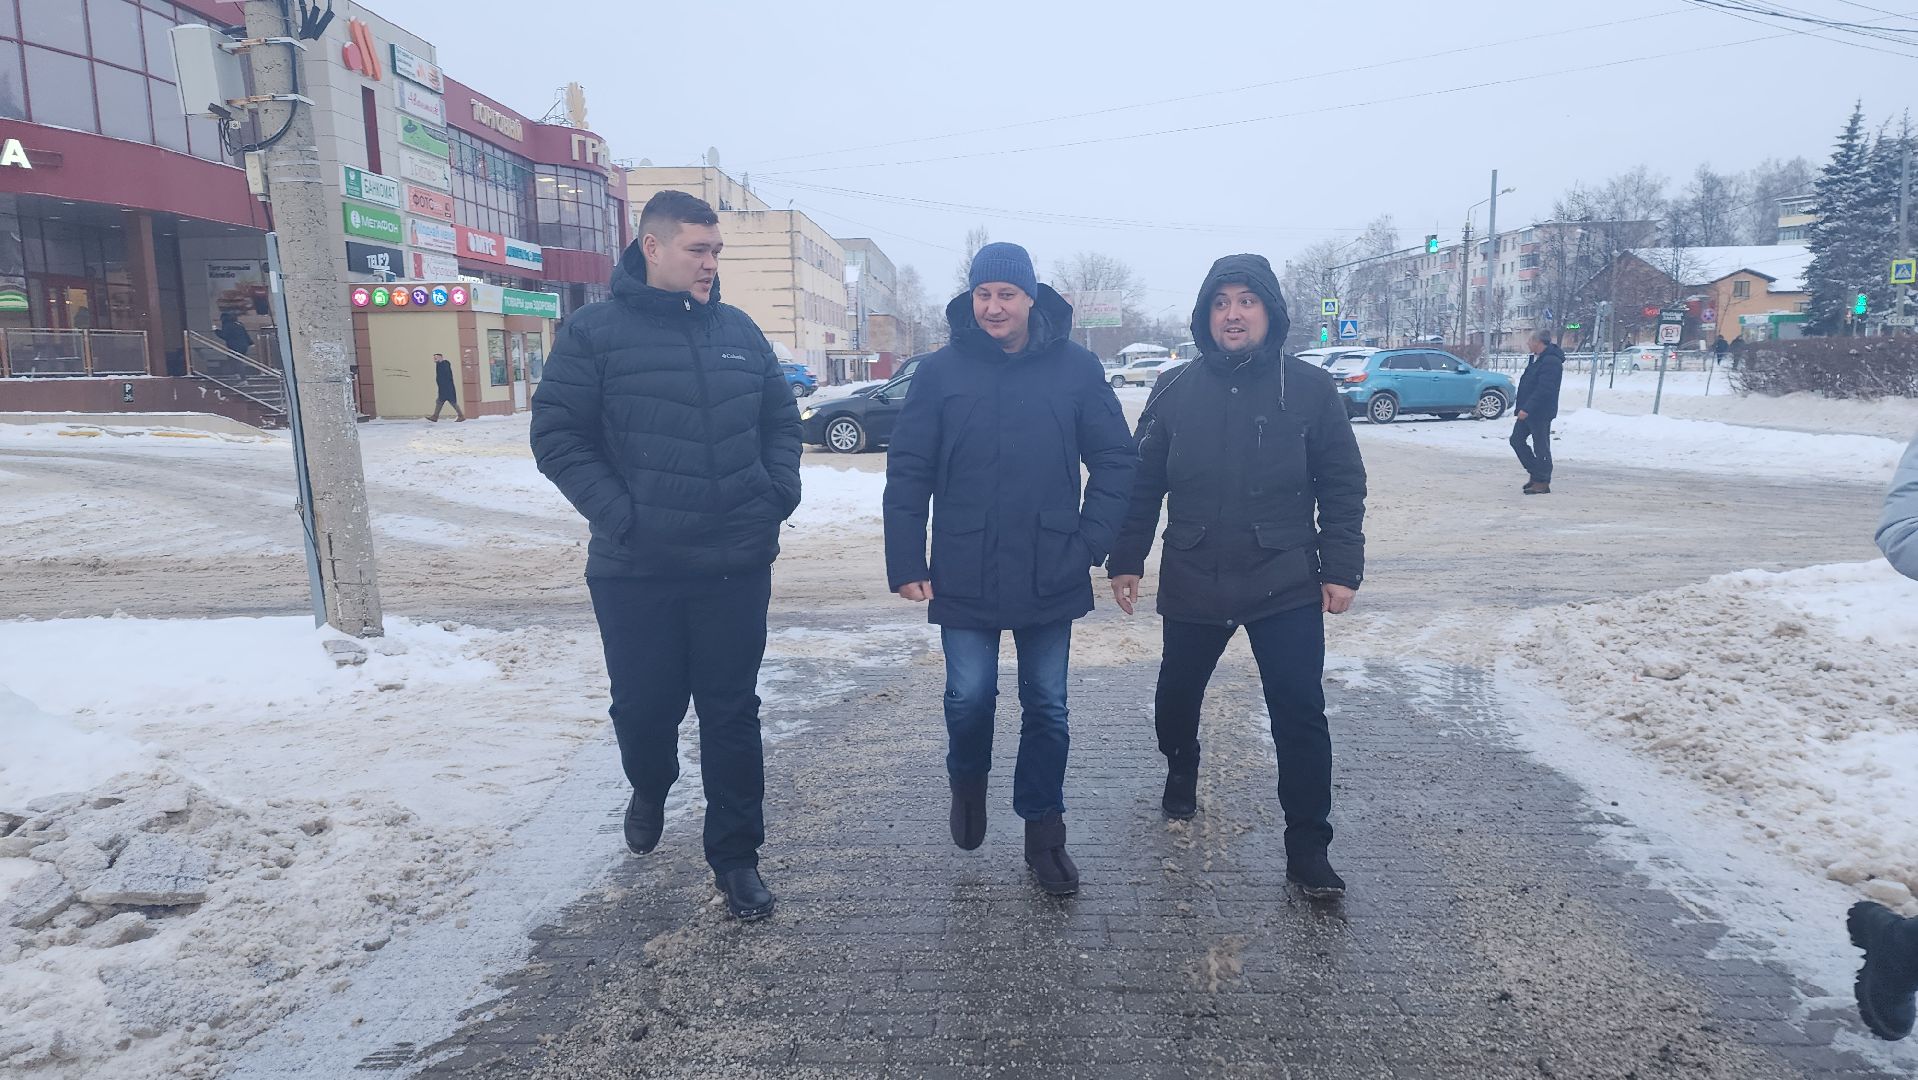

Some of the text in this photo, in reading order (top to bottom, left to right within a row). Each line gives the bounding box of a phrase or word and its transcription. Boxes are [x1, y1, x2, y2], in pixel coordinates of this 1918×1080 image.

[471, 98, 523, 142] ТОРГОВЫЙ
[363, 178, 396, 199] БАНКОМАТ
[366, 252, 390, 270] TELE2
